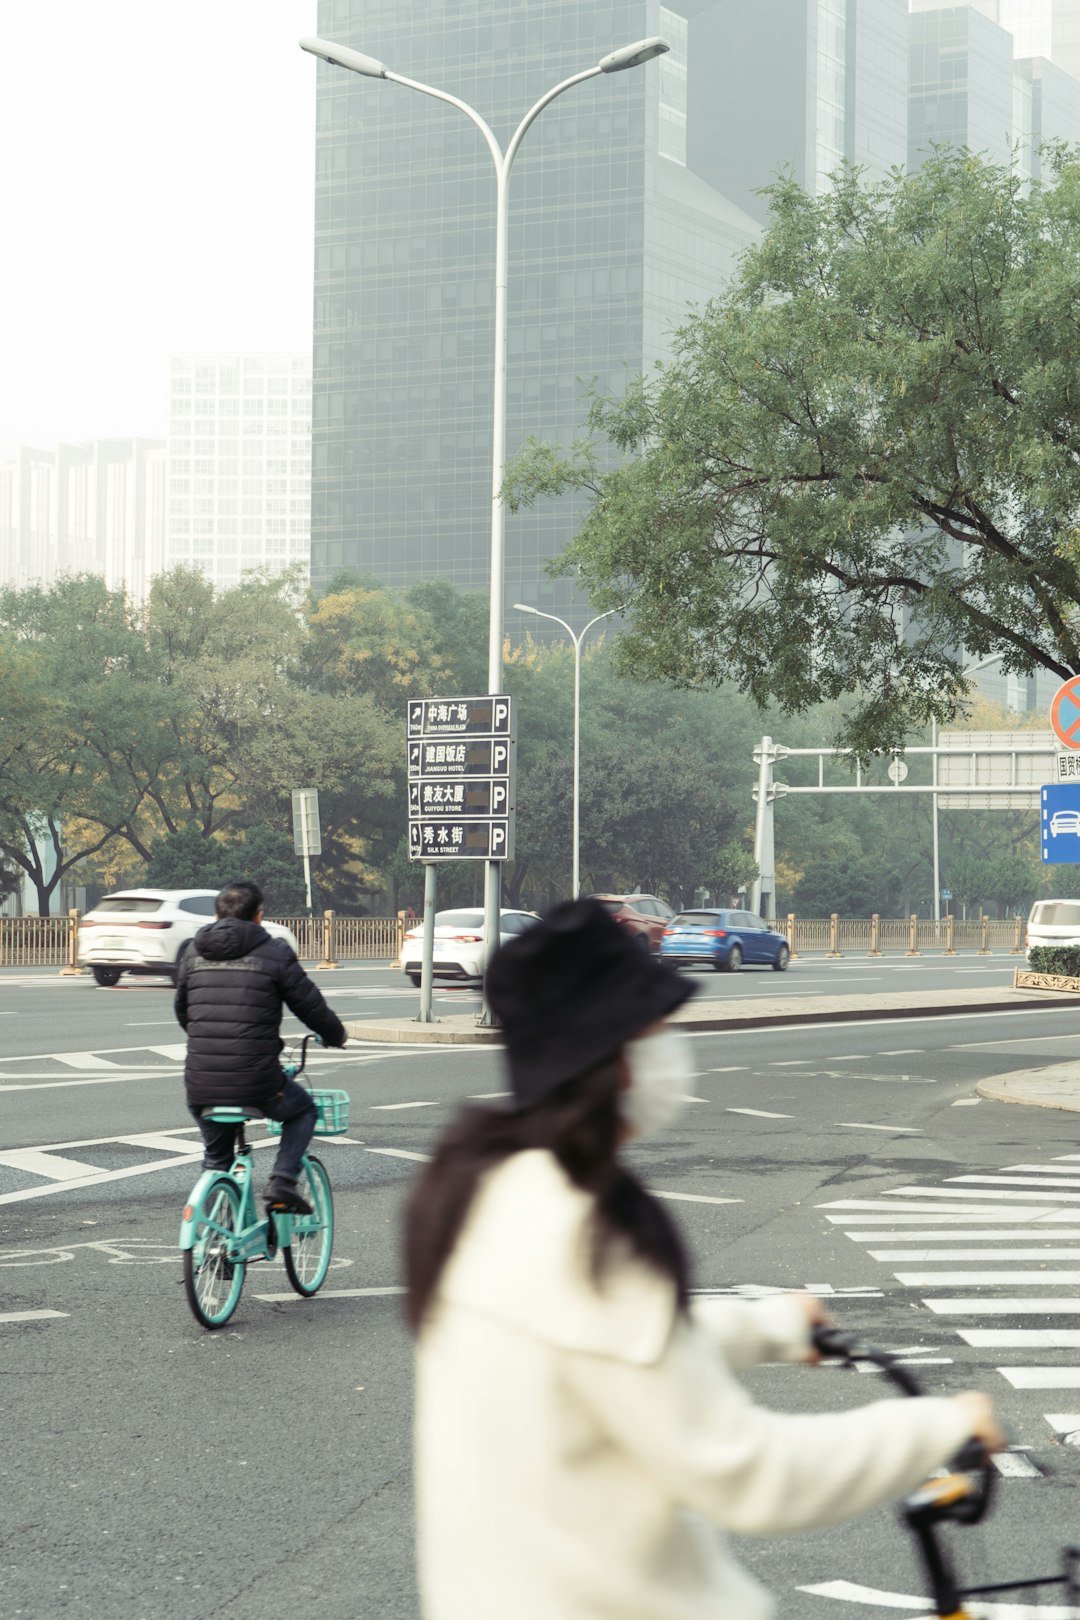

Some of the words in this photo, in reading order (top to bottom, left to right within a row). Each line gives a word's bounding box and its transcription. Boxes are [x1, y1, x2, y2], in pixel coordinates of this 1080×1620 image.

[428, 703, 467, 722] 中海广场
[495, 704, 508, 727] P
[425, 744, 466, 763] 建国饭店
[494, 746, 507, 769] P
[423, 785, 464, 803] 贵友大厦
[493, 786, 506, 809] P
[423, 826, 463, 844] 秀水街
[492, 828, 505, 850] P
